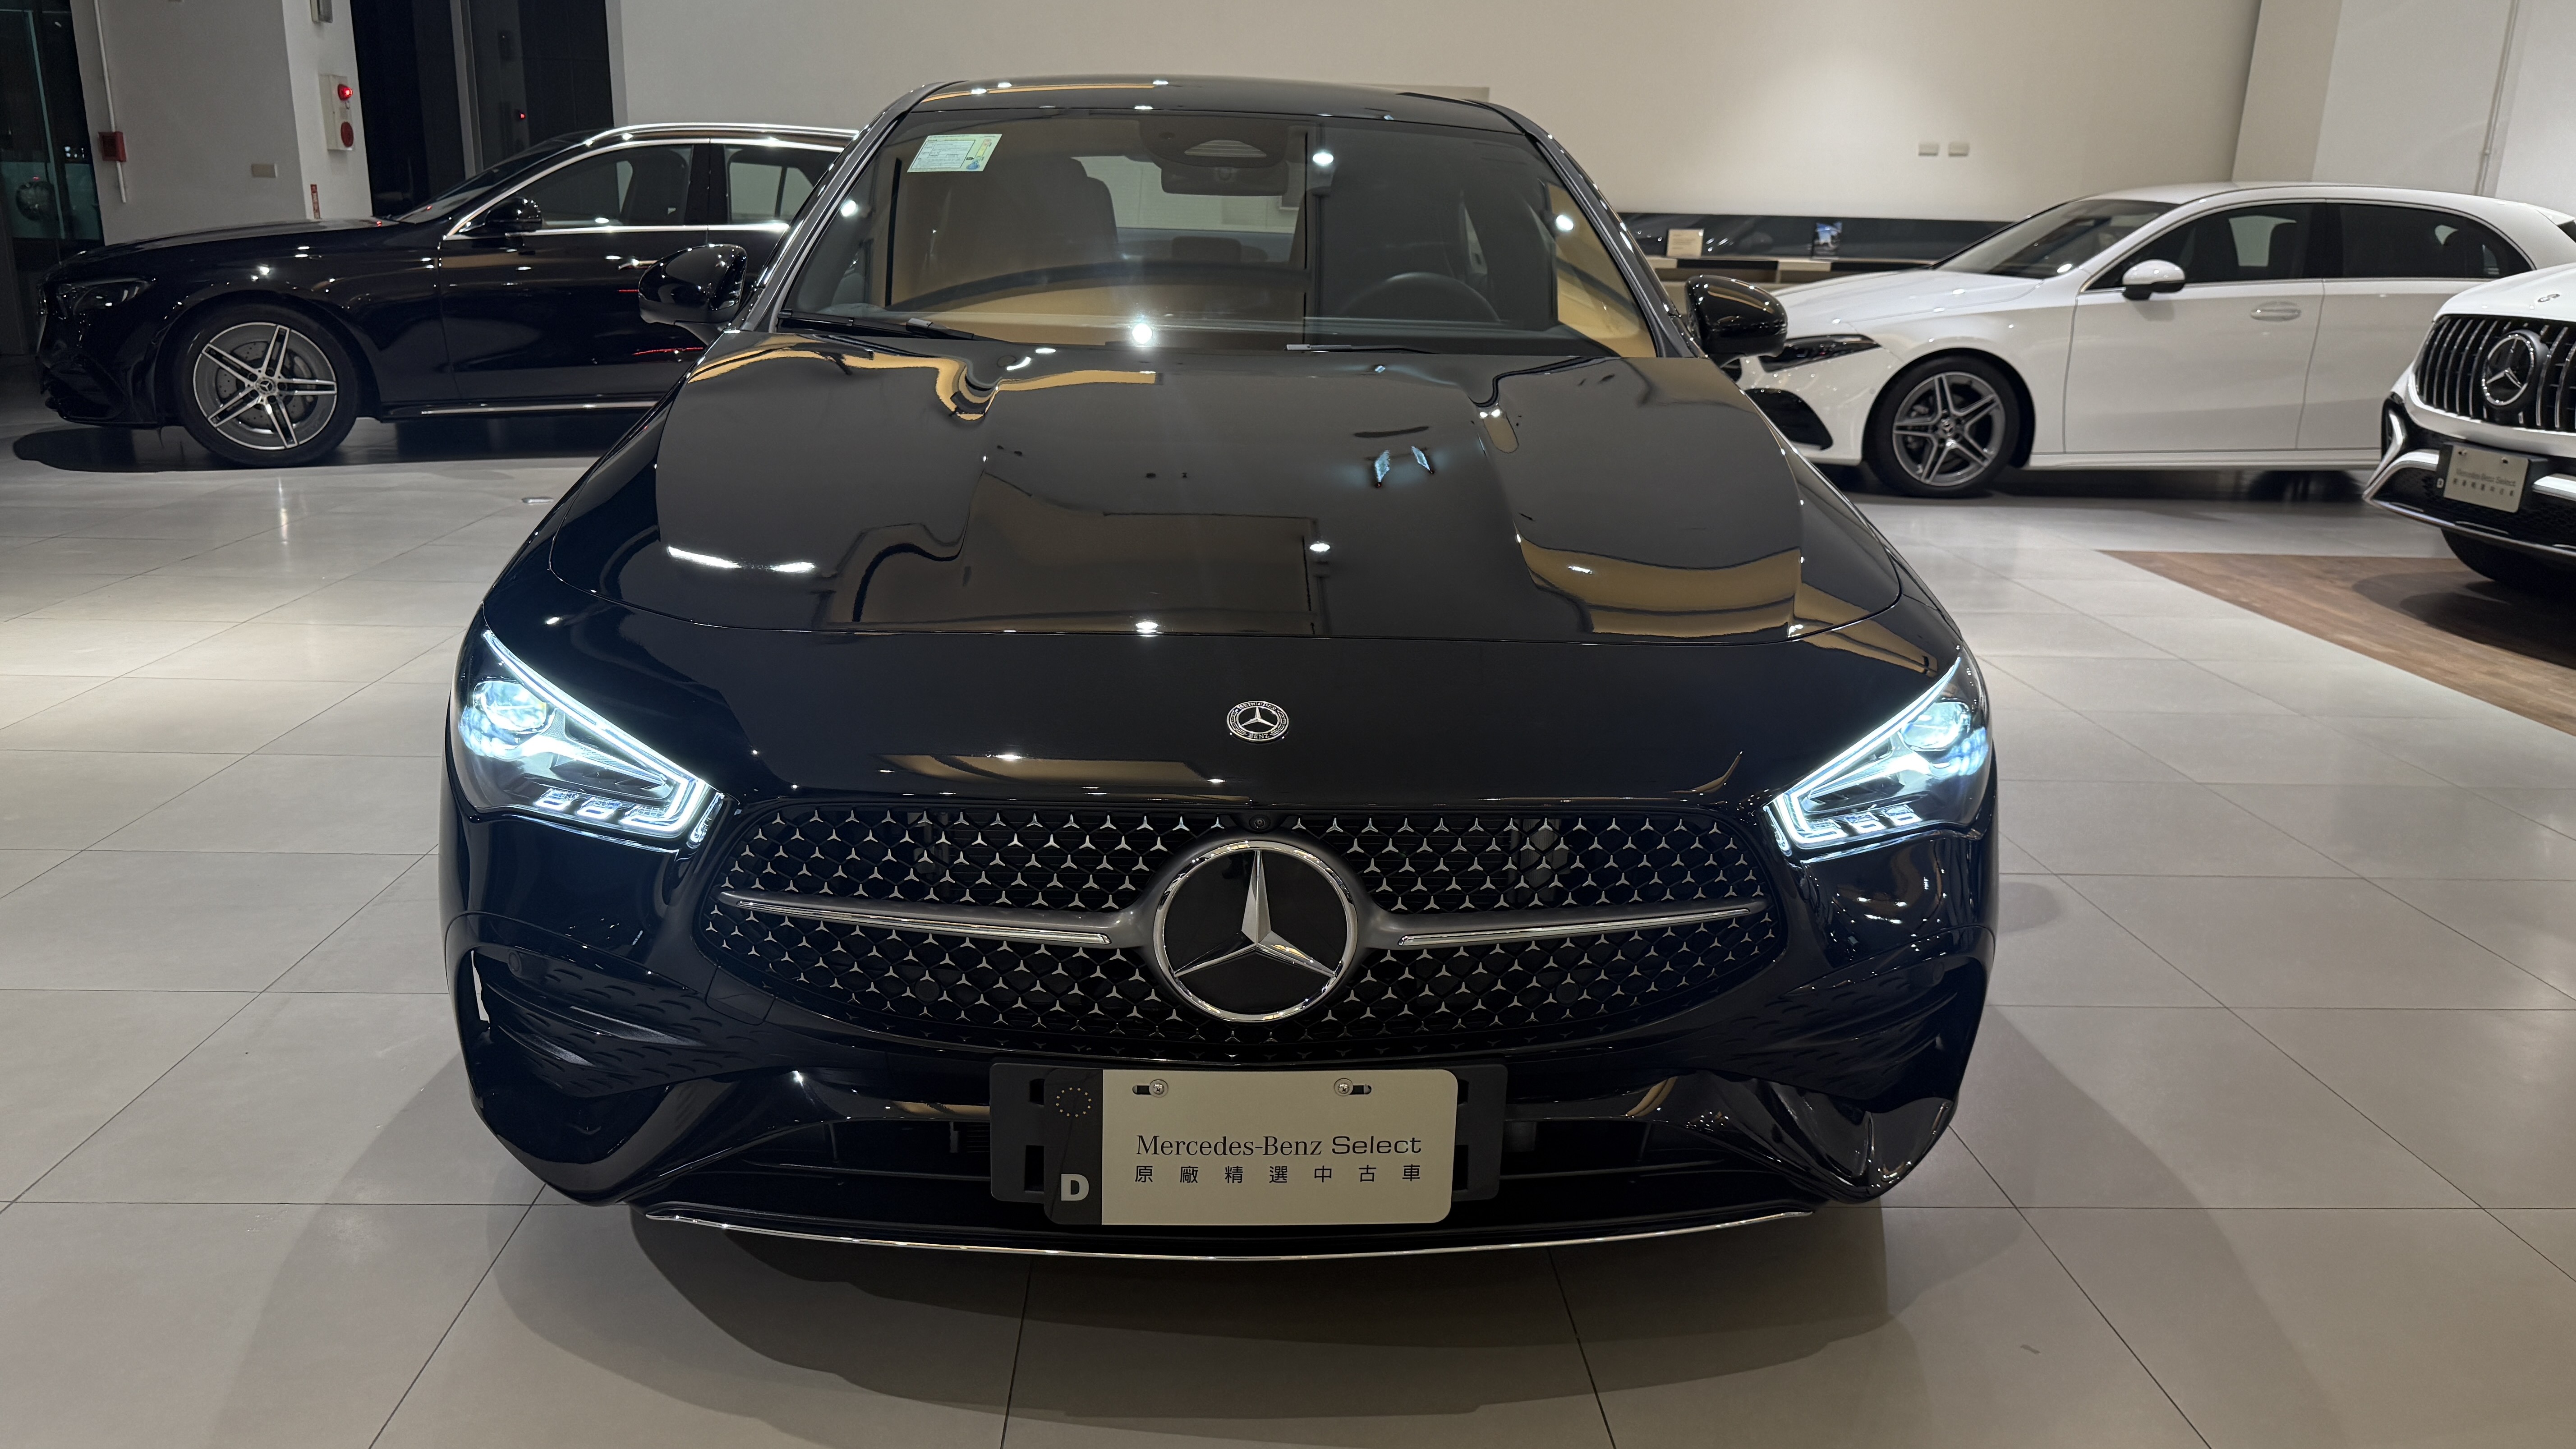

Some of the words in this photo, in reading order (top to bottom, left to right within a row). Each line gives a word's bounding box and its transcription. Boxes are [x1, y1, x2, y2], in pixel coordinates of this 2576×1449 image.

[1136, 1135, 1322, 1156] Mercedes-Benz
[1331, 1135, 1421, 1155] Select
[1134, 1163, 1421, 1184] 原廠精選中古車
[1061, 1173, 1089, 1201] D
